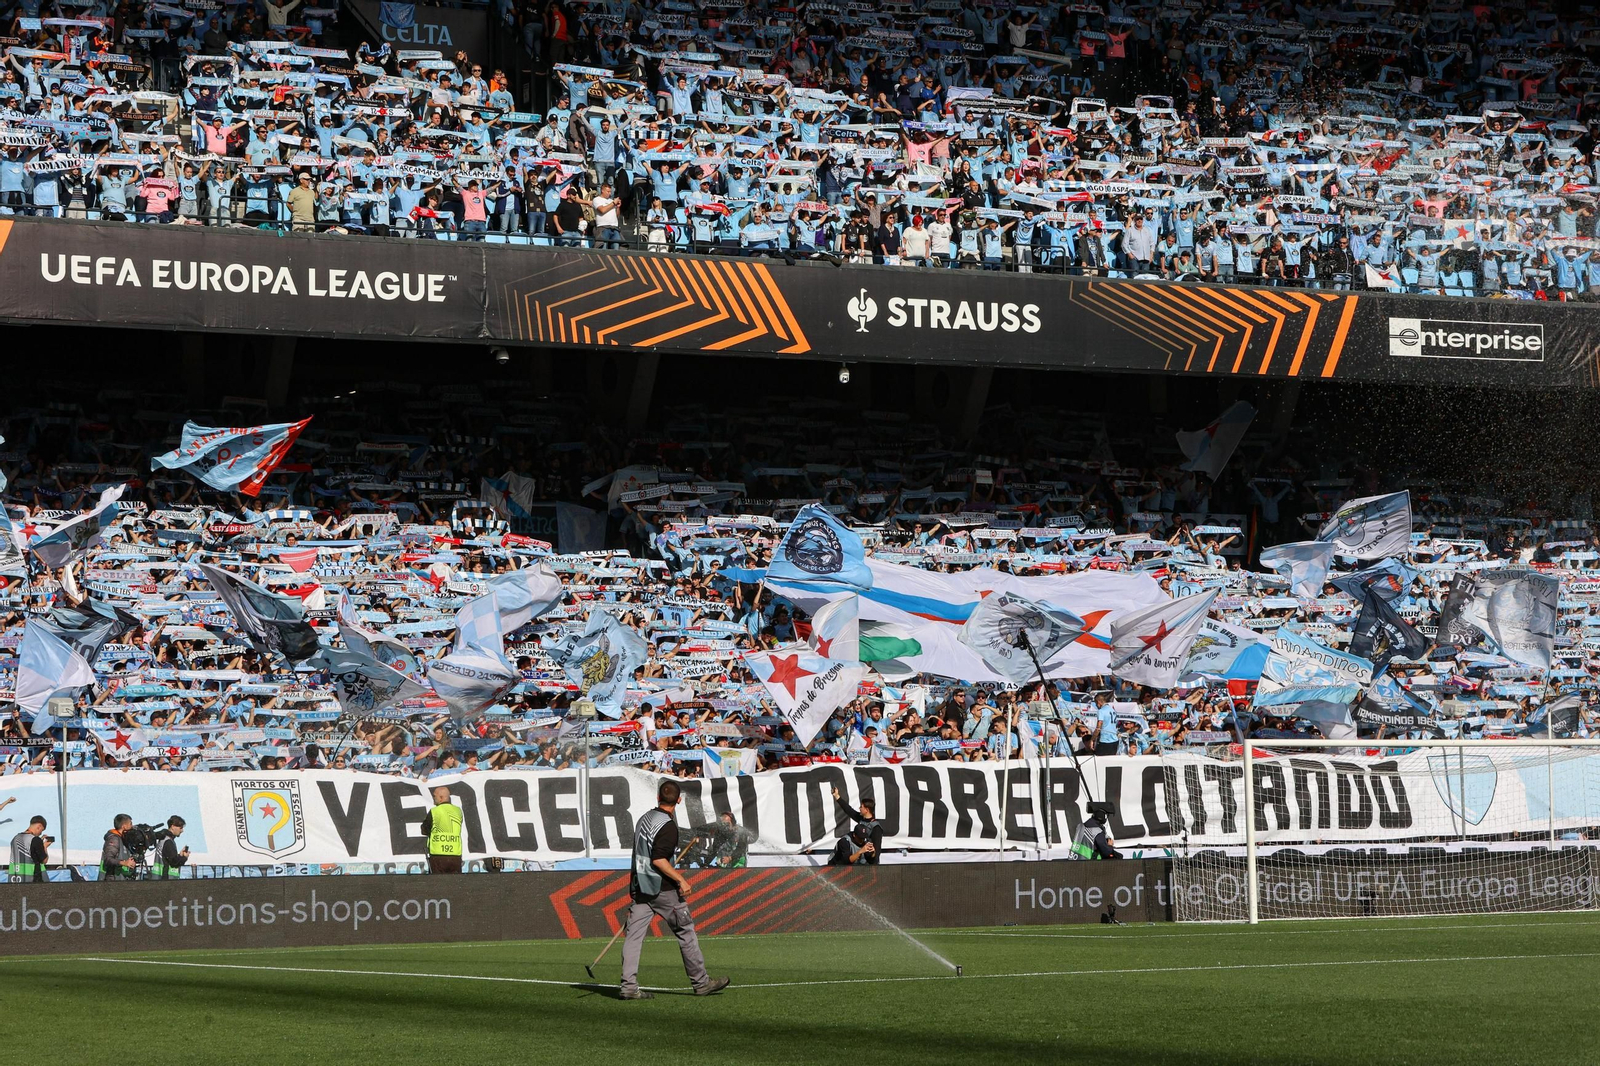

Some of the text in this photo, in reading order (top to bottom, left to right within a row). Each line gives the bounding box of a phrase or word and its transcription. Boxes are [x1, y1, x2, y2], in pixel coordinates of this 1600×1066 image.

[774, 10, 794, 18] Celta
[431, 61, 454, 69] Celta
[580, 66, 600, 75] Celta
[243, 89, 264, 97] Celta
[82, 117, 106, 127] Celta
[27, 124, 50, 133] Celta
[835, 128, 857, 137] Celta
[515, 138, 539, 146] Celta
[661, 152, 682, 160] Celta
[32, 160, 80, 170] COMANDO
[740, 158, 761, 168] Celta
[394, 164, 441, 178] CARCAMANS
[455, 168, 500, 179] CARCAMANS
[1277, 195, 1312, 203] CARCAMANS
[41, 253, 141, 287] UEFA
[153, 259, 298, 296] EUROPA
[308, 268, 447, 303] LEAGUE
[887, 296, 1042, 334] STRAUSS
[1399, 328, 1542, 355] enterprise
[101, 571, 136, 580] CELTA
[120, 588, 131, 596] TEIS
[671, 613, 681, 625] 10
[1274, 637, 1369, 679] IRMANDIÑOS
[682, 665, 724, 677] CARCAMANS
[787, 701, 809, 726] Tropas
[807, 688, 817, 702] de
[1357, 707, 1413, 725] IRMANDIÑOS
[316, 776, 634, 858] VENCER
[779, 765, 1083, 845] MORRER
[1104, 759, 1413, 841] LOITANDO
[235, 797, 247, 840] DENANTES
[292, 793, 303, 841] ESCRAVOS
[1069, 851, 1078, 860] 30
[1015, 878, 1107, 909] Home
[1114, 873, 1144, 907] of
[1154, 874, 1206, 905] the
[1216, 870, 1321, 903] Official
[1333, 870, 1412, 902] UEFA
[1422, 870, 1520, 905] Europa
[0, 890, 451, 937] ubcompetitions-shop.com
